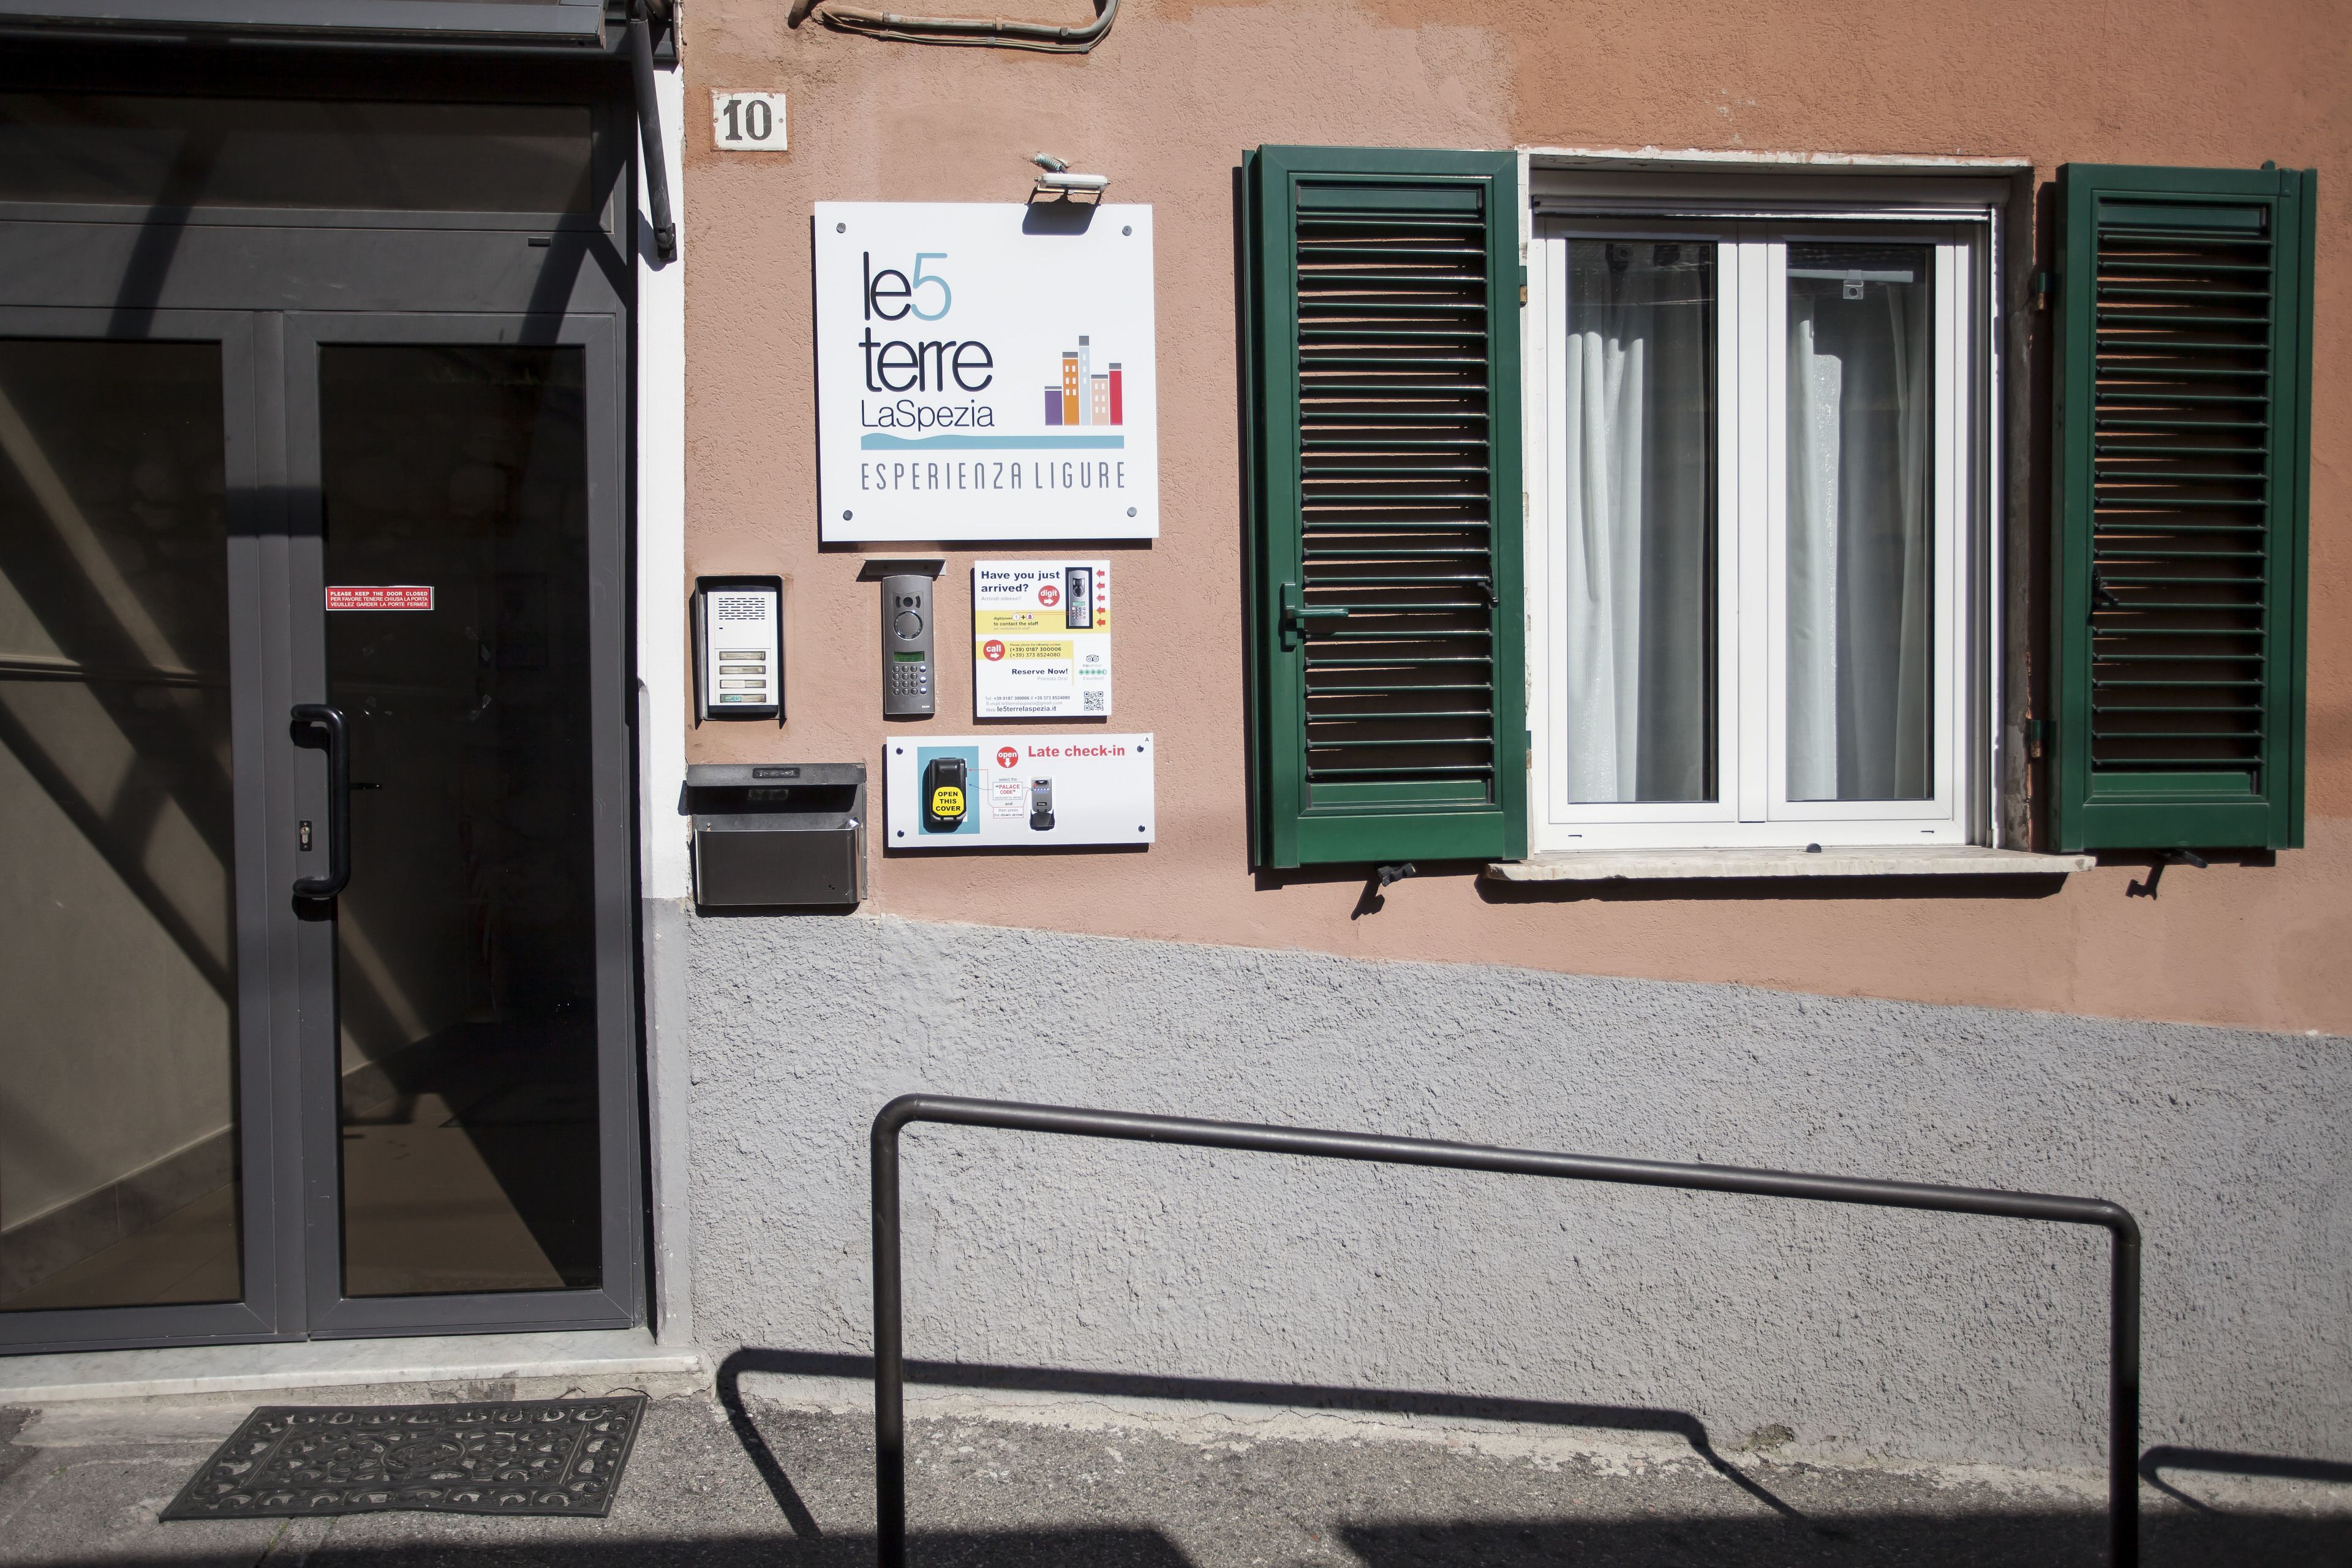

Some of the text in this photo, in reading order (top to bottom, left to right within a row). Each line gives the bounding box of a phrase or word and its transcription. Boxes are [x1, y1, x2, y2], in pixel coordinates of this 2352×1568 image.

[723, 99, 772, 141] 10
[858, 327, 993, 393] terre
[861, 399, 995, 432] LaSpezia
[861, 462, 1125, 490] ESPERIENZA LIGURE
[981, 571, 1060, 581] Have you just
[981, 584, 1029, 592] arrived?
[1040, 589, 1058, 598] digit
[1028, 744, 1125, 758] Late check-in
